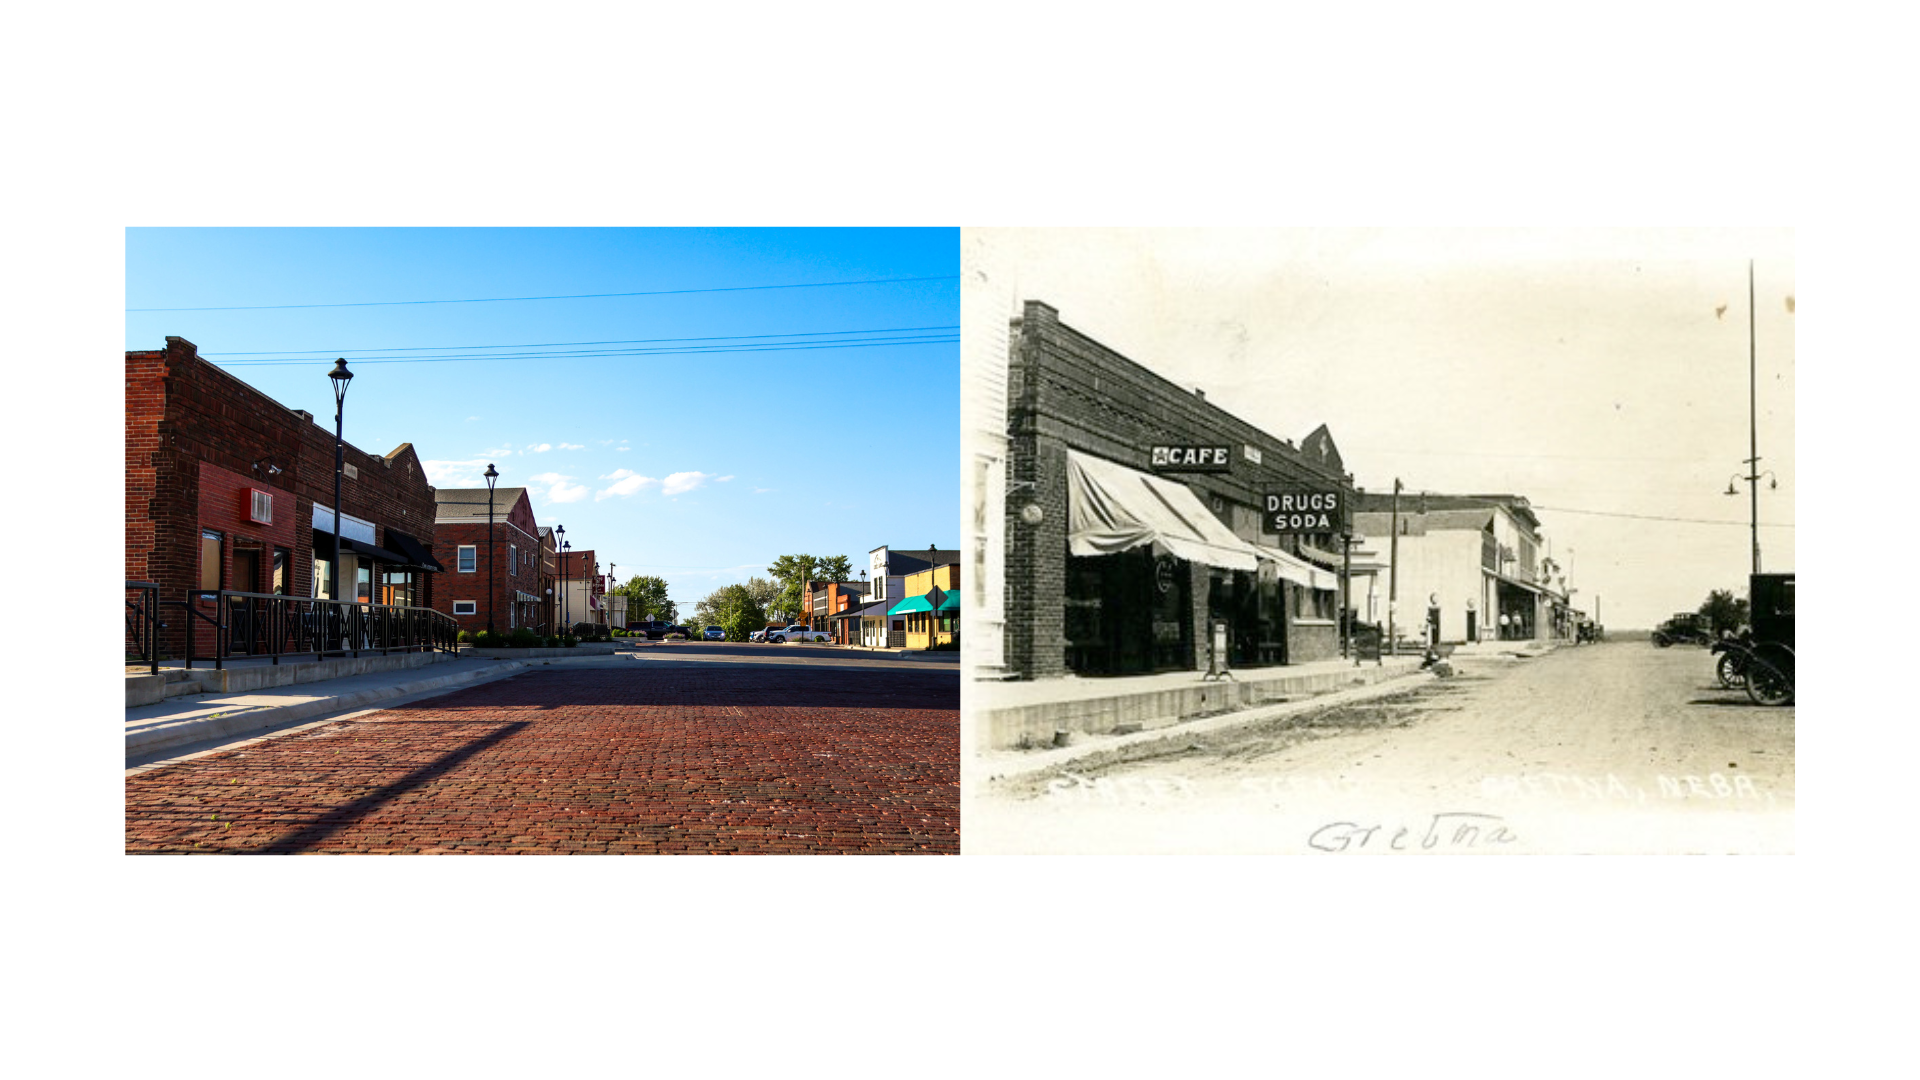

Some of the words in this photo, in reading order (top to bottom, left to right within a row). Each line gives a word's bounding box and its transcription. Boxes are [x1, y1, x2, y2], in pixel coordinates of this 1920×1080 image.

[1169, 448, 1228, 464] CAFE
[1267, 493, 1336, 511] DRUGS
[1274, 513, 1330, 529] SODA
